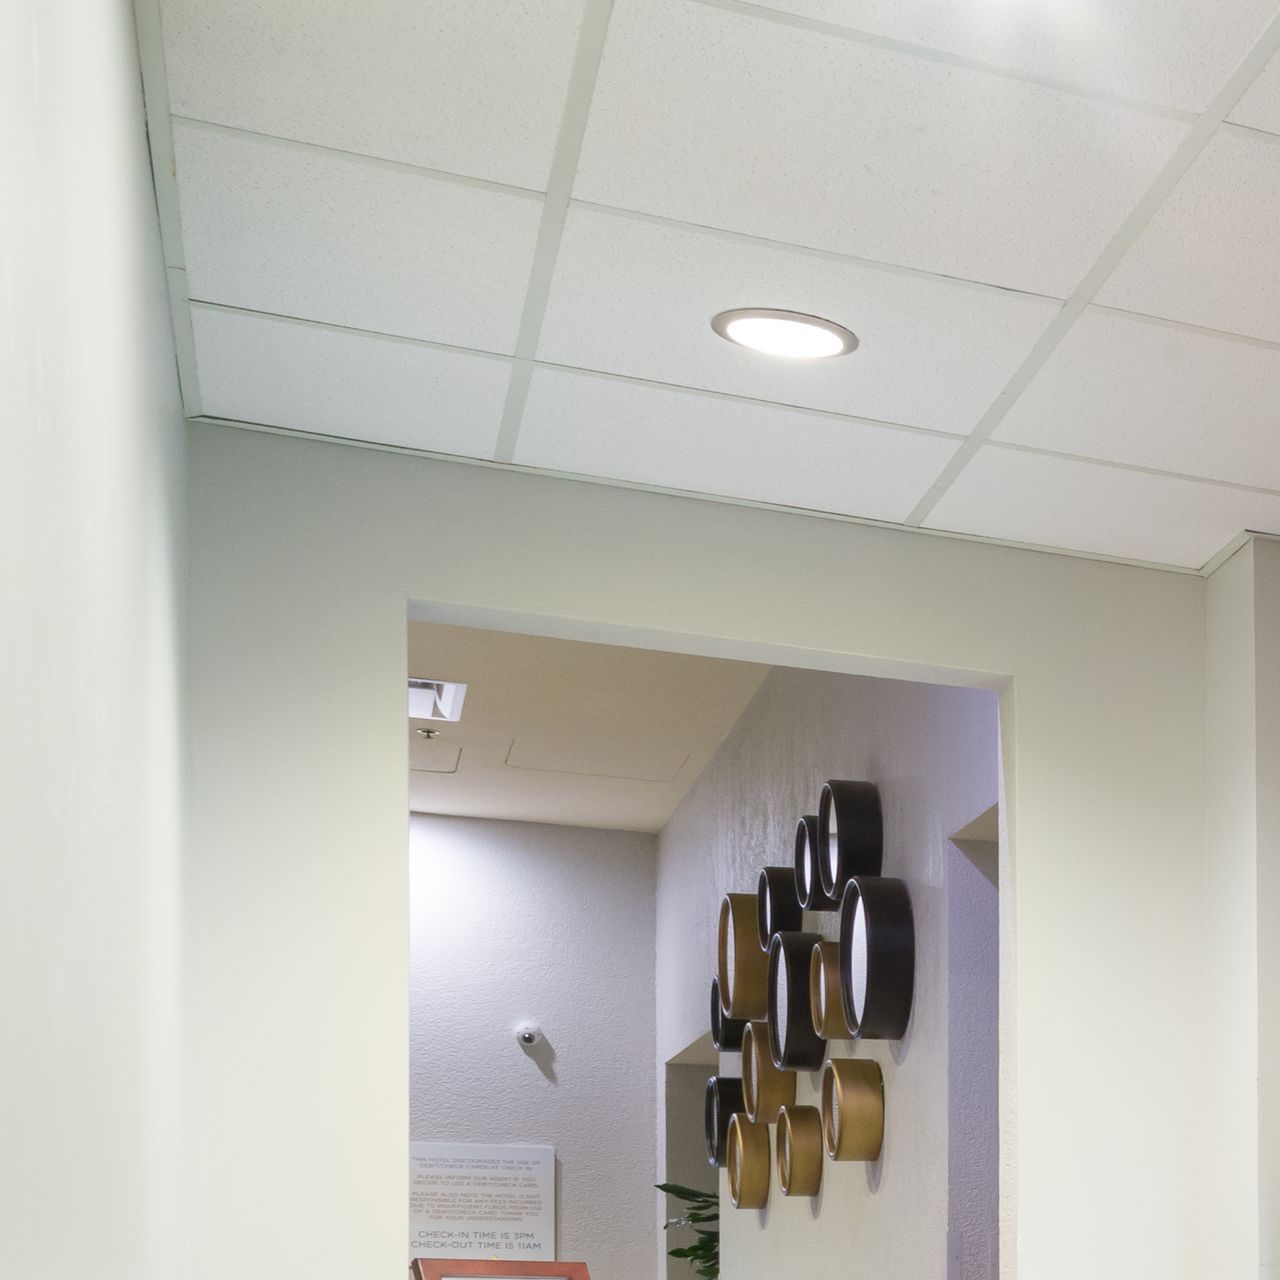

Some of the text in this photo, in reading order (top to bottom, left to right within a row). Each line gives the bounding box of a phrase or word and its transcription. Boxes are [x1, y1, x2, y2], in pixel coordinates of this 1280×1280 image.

[417, 1230, 535, 1240] CHECK-IN TIME IS 3PM
[410, 1240, 473, 1249] CHECK-OUT
[477, 1241, 503, 1249] TIME
[518, 1242, 542, 1250] 11AM
